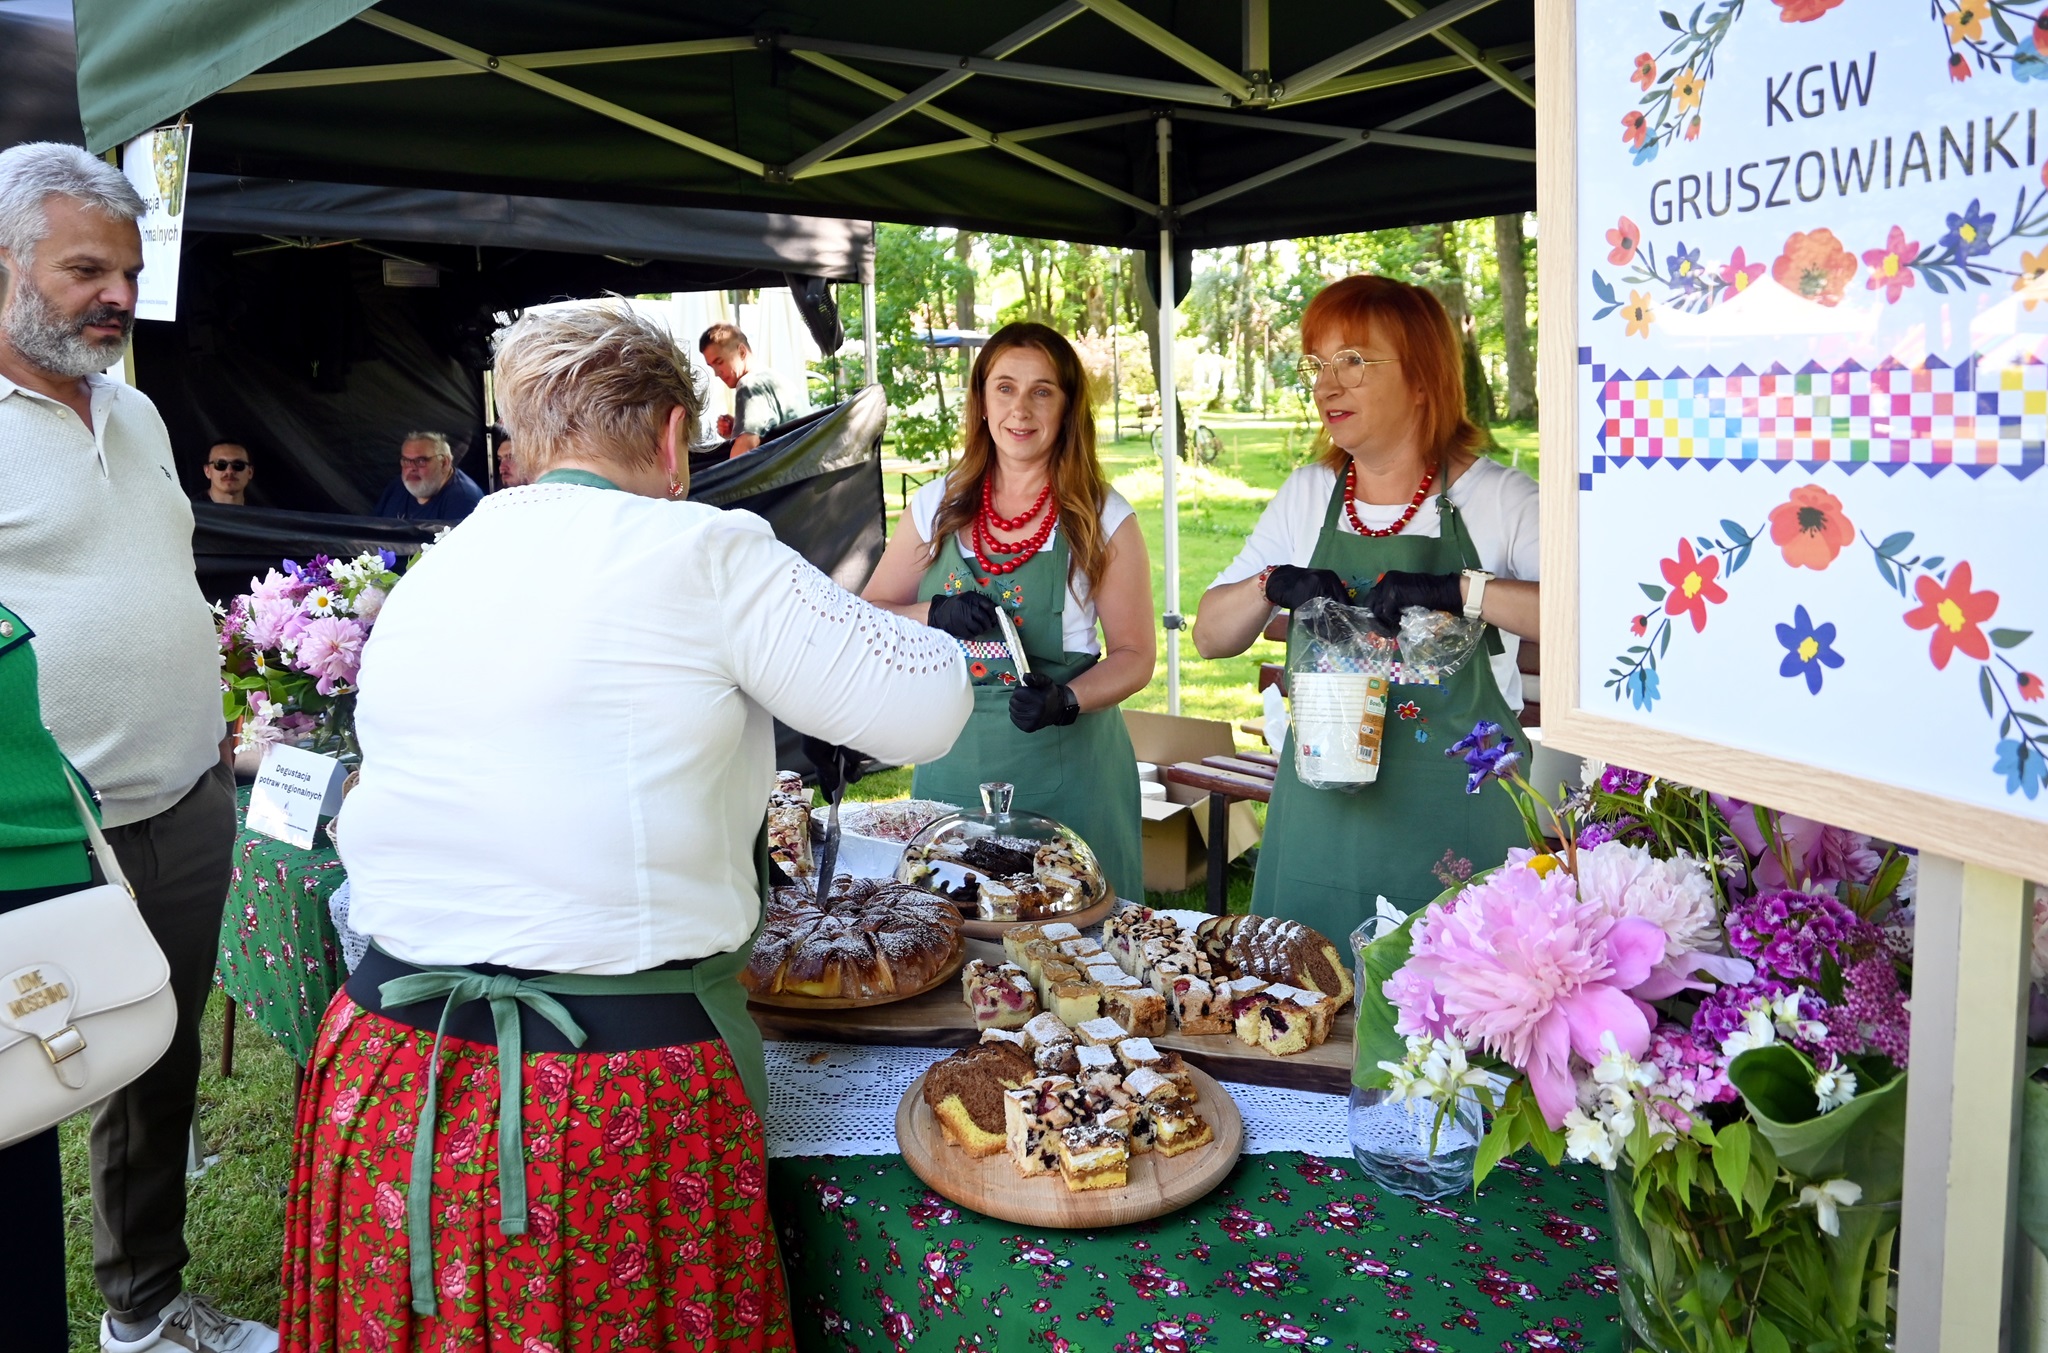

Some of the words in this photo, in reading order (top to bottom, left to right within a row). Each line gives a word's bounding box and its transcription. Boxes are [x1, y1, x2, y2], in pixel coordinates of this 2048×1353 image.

[1766, 51, 1876, 127] KGW
[1650, 109, 2037, 226] GRUSZOWIANKI
[141, 224, 179, 246] ionalnych
[276, 764, 311, 782] Degustacja
[259, 776, 280, 788] potraw
[281, 782, 322, 800] regionalnych
[13, 969, 47, 995] LOVE
[7, 982, 68, 1019] MOSCHINO
